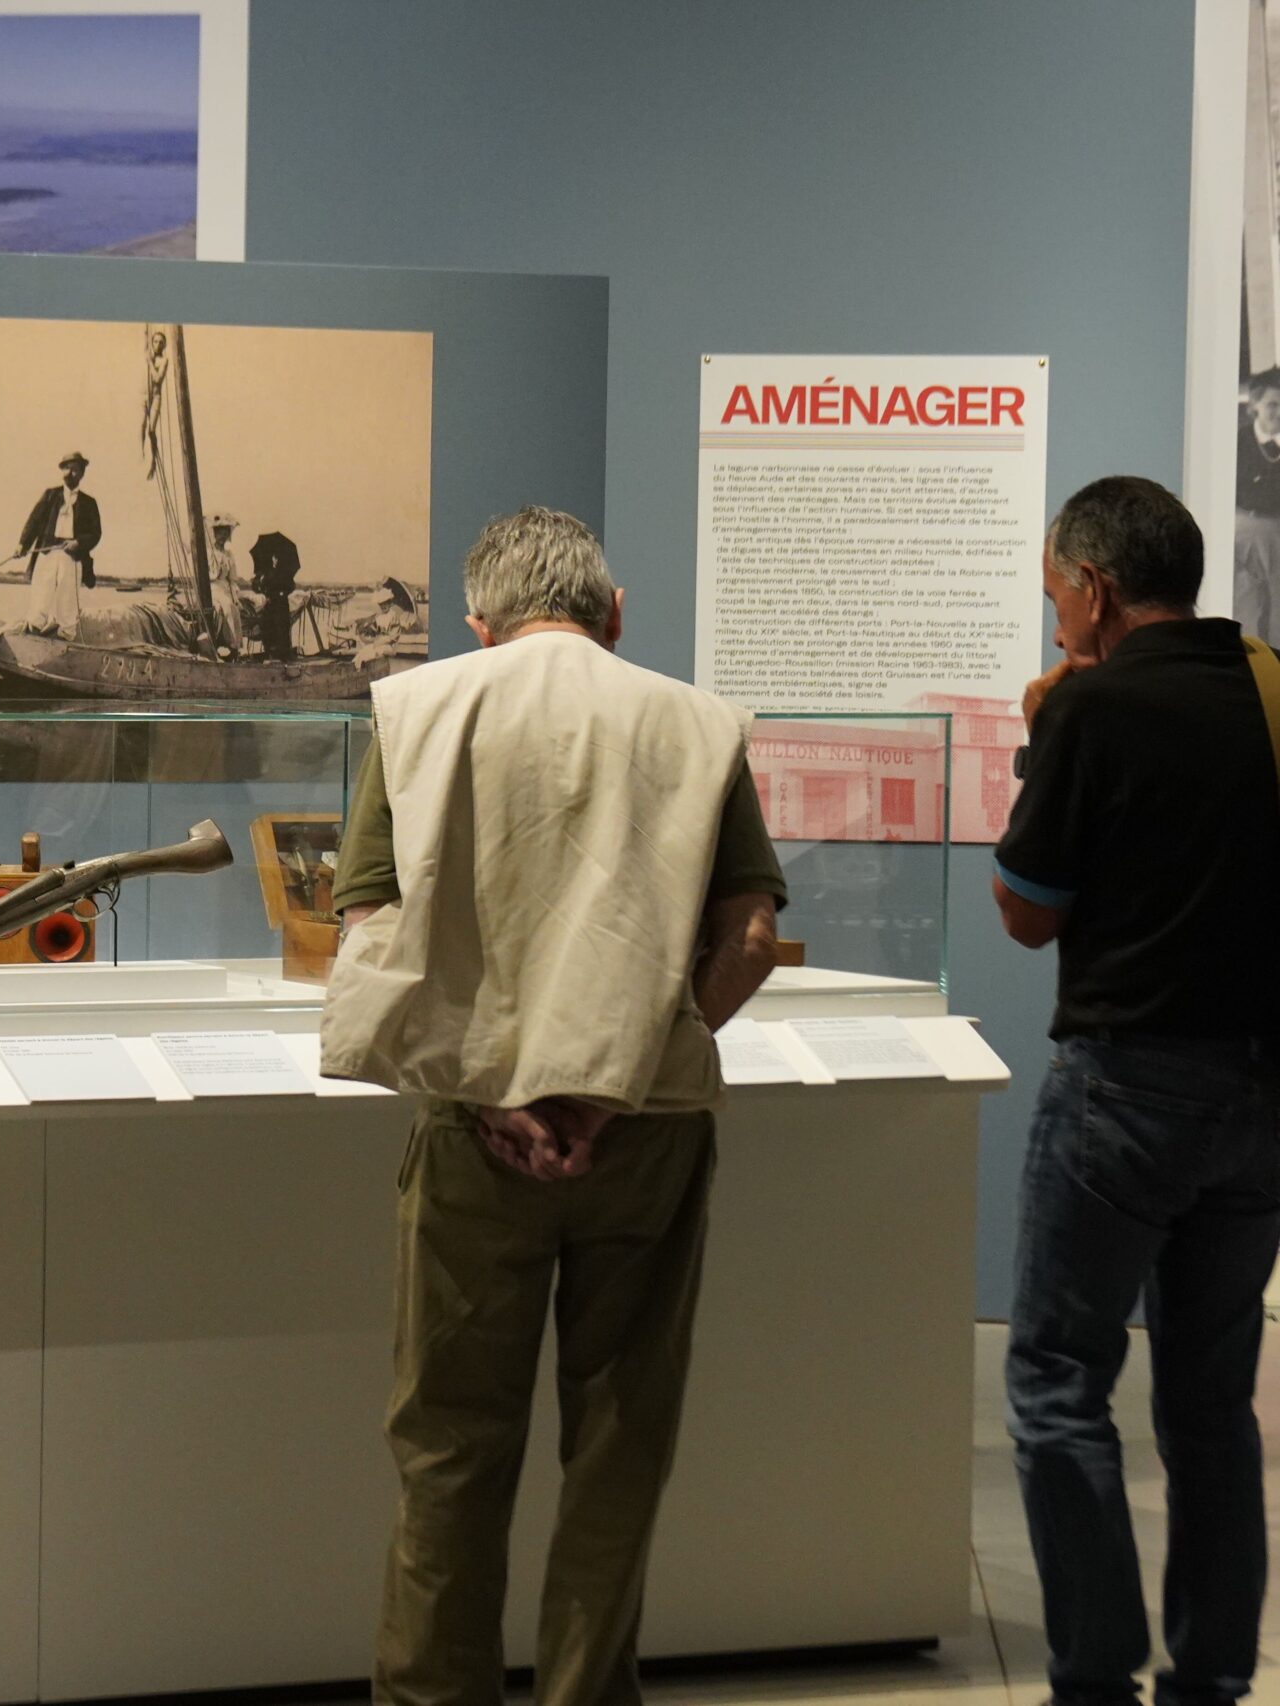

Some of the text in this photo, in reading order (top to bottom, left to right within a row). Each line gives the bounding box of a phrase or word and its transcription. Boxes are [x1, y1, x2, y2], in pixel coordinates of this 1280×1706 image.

[721, 376, 1026, 427] AMÉNAGER
[715, 597, 744, 607] coupé
[758, 597, 789, 607] lagune
[834, 598, 858, 606] dans
[945, 599, 999, 610] provoquant
[715, 607, 873, 619] l'envasement accéléré des étangs
[721, 617, 1019, 630] la construction de différents ports Port-la-Nouvelle partir du
[715, 627, 742, 636] milieu
[745, 628, 757, 636] du
[813, 629, 822, 637] et
[826, 629, 905, 639] Port-la-Nautique
[922, 630, 950, 638] début
[953, 630, 965, 638] du
[986, 631, 1013, 639] siècle
[720, 637, 745, 646] cette
[747, 638, 790, 646] évolution
[806, 638, 847, 649] prolonge
[850, 639, 873, 647] dans
[876, 639, 889, 648] les
[892, 640, 927, 648] années
[930, 640, 952, 648] 1960
[979, 641, 988, 649] le
[714, 649, 996, 661] programme d'aménagement et de développement du littoral
[714, 658, 726, 666] du
[729, 658, 832, 669] Languedoc-Roussillon
[835, 659, 874, 669] (mission
[877, 660, 909, 668] Racine
[992, 661, 1000, 670] la
[714, 668, 990, 680] création de stations balnéaires dont Gruissan est l'une des
[714, 678, 767, 687] réalisations
[848, 680, 872, 690] signe
[875, 681, 887, 689] de
[714, 689, 770, 697] l'avènement
[773, 690, 784, 698] de
[787, 690, 796, 698] la
[798, 690, 832, 698] société
[835, 690, 852, 699] des
[746, 742, 913, 764] AVILLON NAUTIQUE
